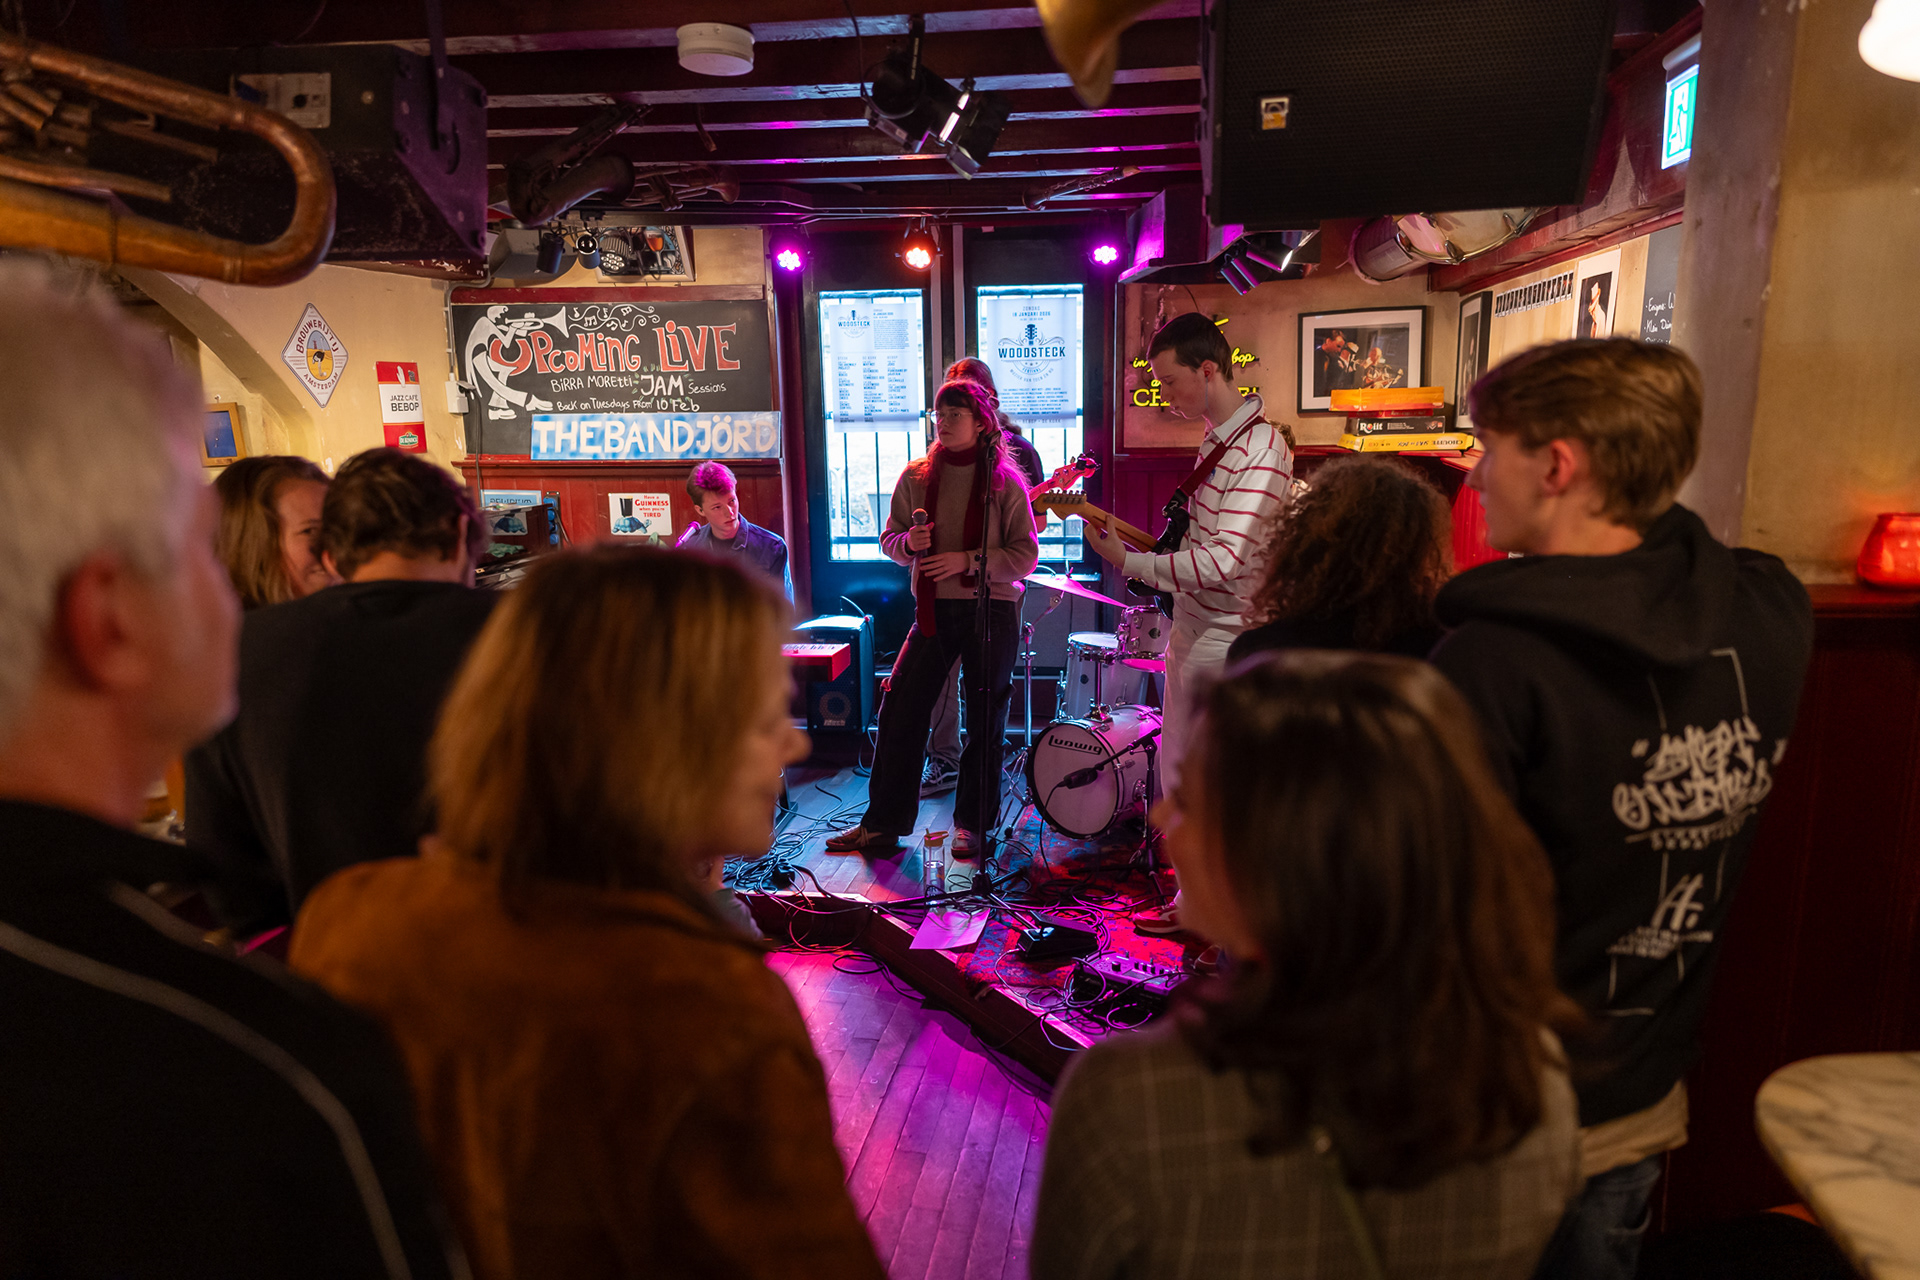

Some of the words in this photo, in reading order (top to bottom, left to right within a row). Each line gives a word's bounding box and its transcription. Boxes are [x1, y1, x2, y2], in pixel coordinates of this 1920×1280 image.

[296, 320, 329, 353] BROUWERIJ
[998, 346, 1066, 358] WOODSTECK
[304, 372, 338, 390] AMSTERDAM
[640, 374, 685, 396] JAM
[688, 383, 727, 394] Sessions
[391, 402, 419, 411] BEBOP
[556, 400, 578, 411] Back
[590, 397, 630, 413] Tuesdays
[657, 400, 668, 410] 10
[672, 399, 700, 412] Feb
